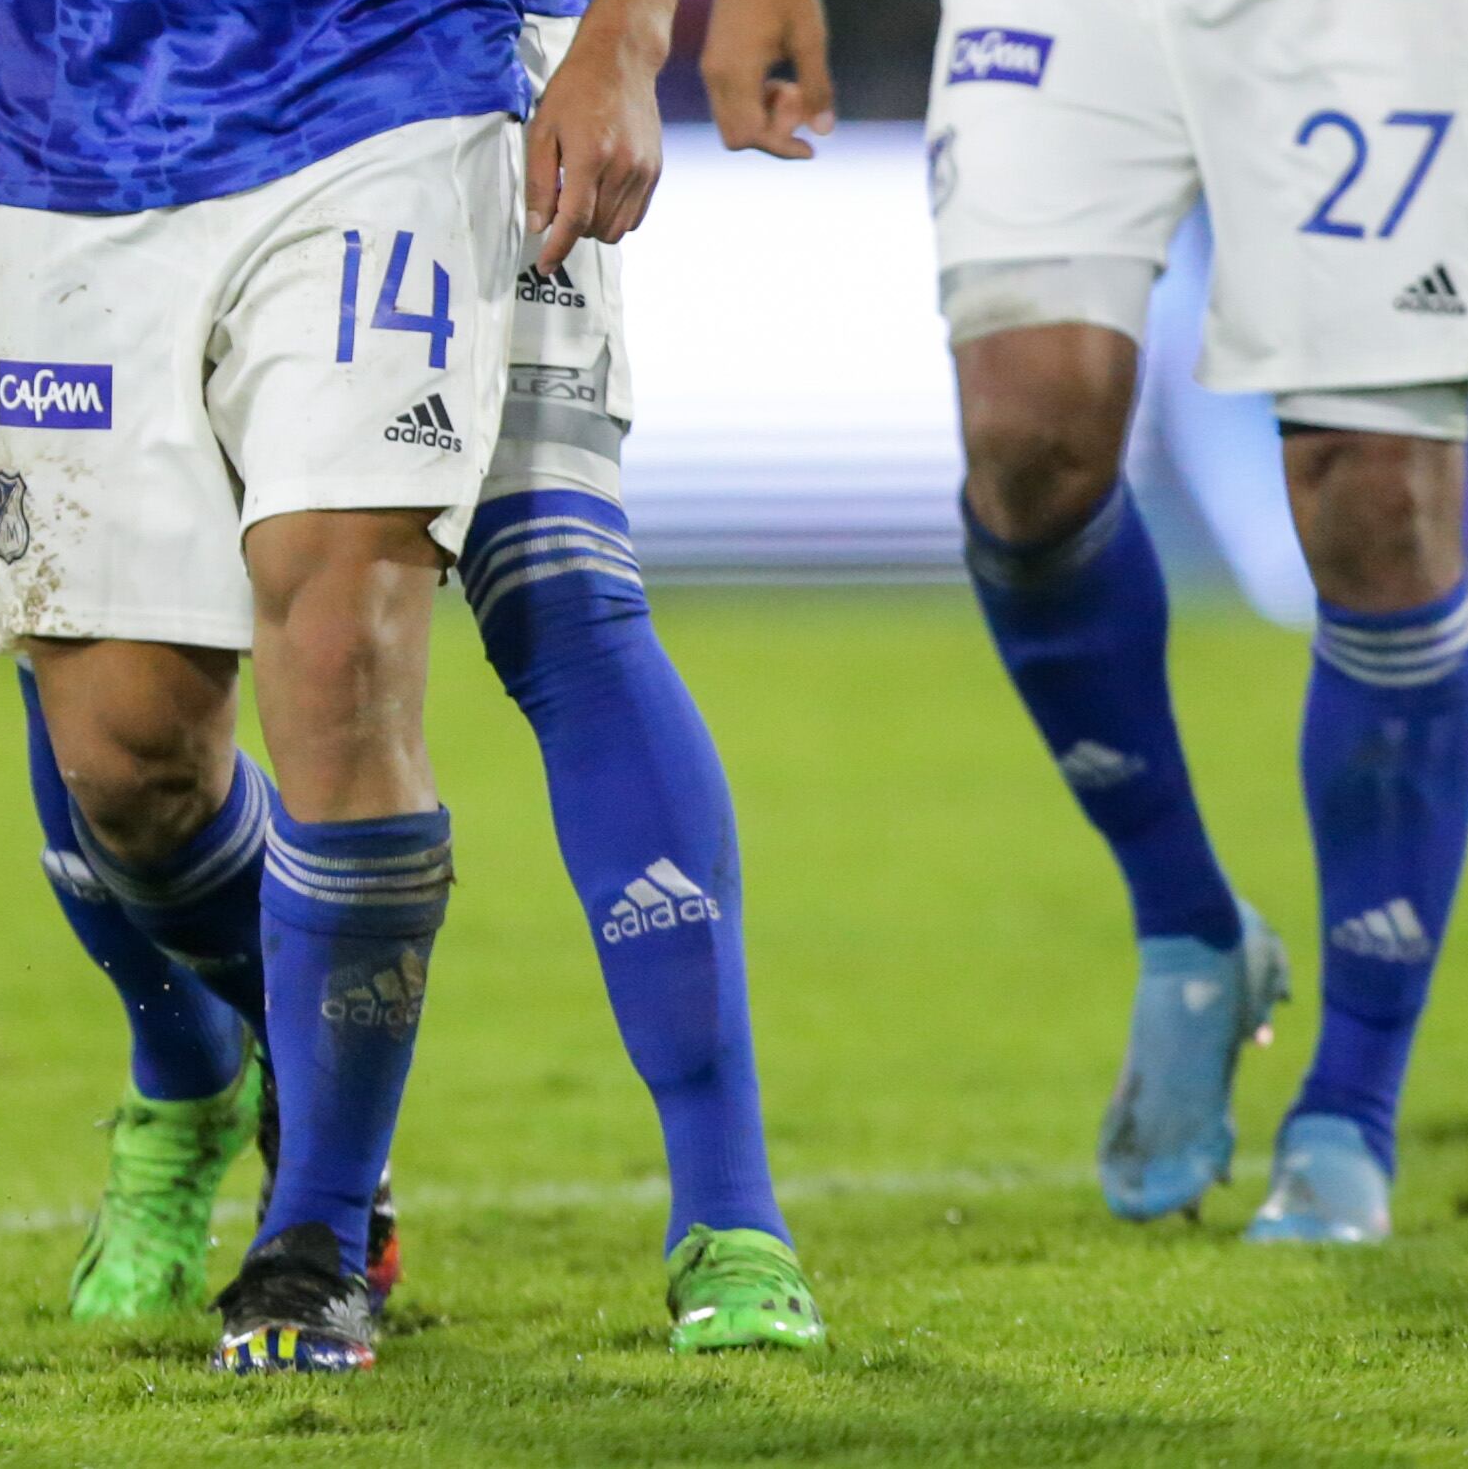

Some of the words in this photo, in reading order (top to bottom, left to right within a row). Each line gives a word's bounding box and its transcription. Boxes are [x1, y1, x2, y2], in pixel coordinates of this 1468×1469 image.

[1295, 108, 1456, 240] 27
[336, 229, 455, 369] 14
[384, 423, 463, 453] adidas
[601, 897, 722, 945] adidas
